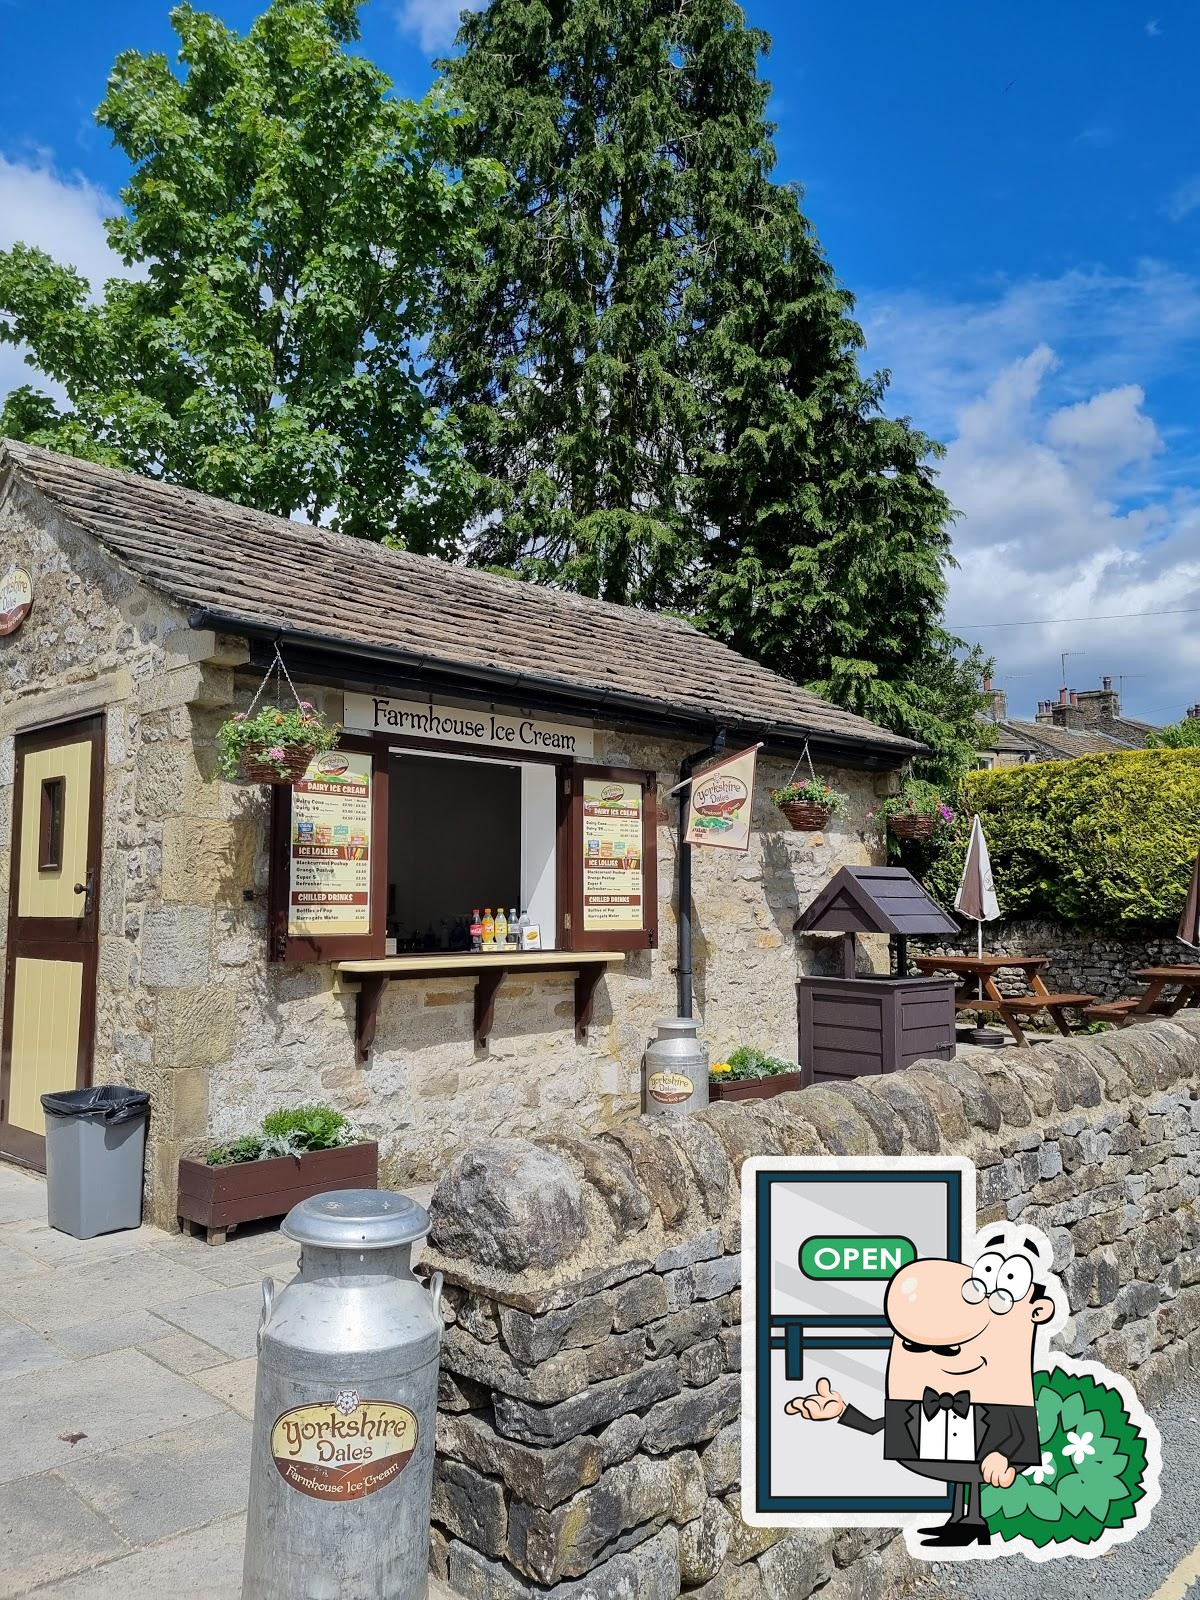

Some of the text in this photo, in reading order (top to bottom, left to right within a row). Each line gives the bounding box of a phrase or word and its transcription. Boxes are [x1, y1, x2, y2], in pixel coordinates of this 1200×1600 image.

[372, 698, 576, 752] Farmhouse Ice Cream
[307, 782, 366, 795] DAIRY ICE CREAM
[298, 847, 339, 856] ICE LOLLIES
[298, 893, 354, 901] CHILLED DRINKS
[316, 1439, 373, 1462] Dales
[285, 1462, 399, 1493] Farmhouse Ice Cream
